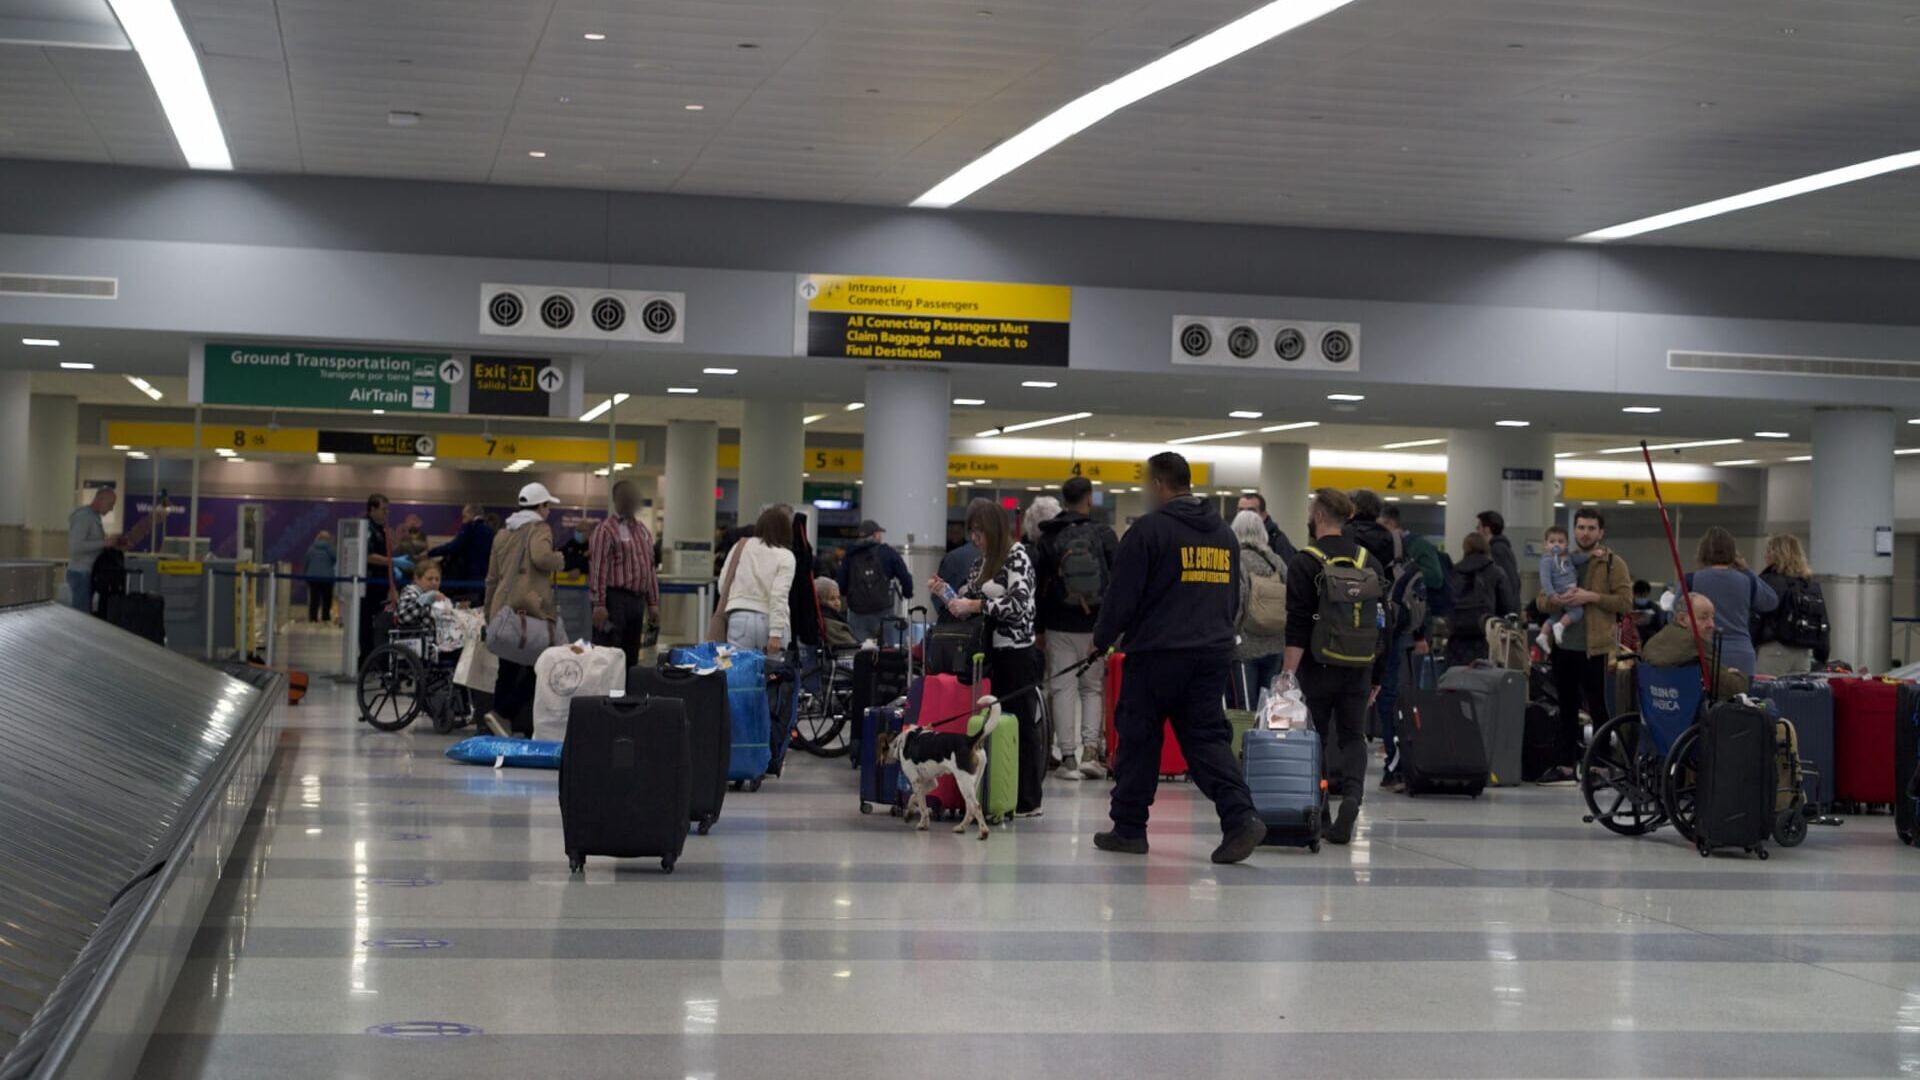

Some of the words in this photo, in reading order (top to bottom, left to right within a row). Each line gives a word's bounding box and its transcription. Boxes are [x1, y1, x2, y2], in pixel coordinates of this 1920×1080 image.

[848, 282, 897, 294] Intransit
[848, 294, 913, 310] Connecting
[915, 298, 979, 312] Passengers
[848, 316, 864, 327] All
[866, 317, 931, 332] Connecting
[933, 320, 997, 335] Passengers
[1000, 322, 1029, 334] Must
[847, 330, 878, 342] Claim
[881, 332, 931, 346] Baggage
[933, 334, 956, 346] and
[957, 335, 1010, 348] Re-Check
[1014, 339, 1028, 348] to
[846, 344, 873, 356] Final
[875, 346, 942, 359] Destination
[231, 350, 291, 366] Ground
[294, 353, 411, 371] Transportation
[320, 369, 367, 380] Transporte
[368, 372, 384, 381] por
[475, 363, 507, 379] Exit
[349, 387, 408, 403] AirTrain
[234, 430, 246, 447] 8
[486, 439, 497, 456] 7
[816, 452, 827, 469] 5
[970, 461, 999, 471] Exam
[1072, 462, 1082, 476] 4
[1386, 473, 1397, 490] 2
[1623, 482, 1631, 498] 1
[1196, 547, 1231, 571] CUSTOMS
